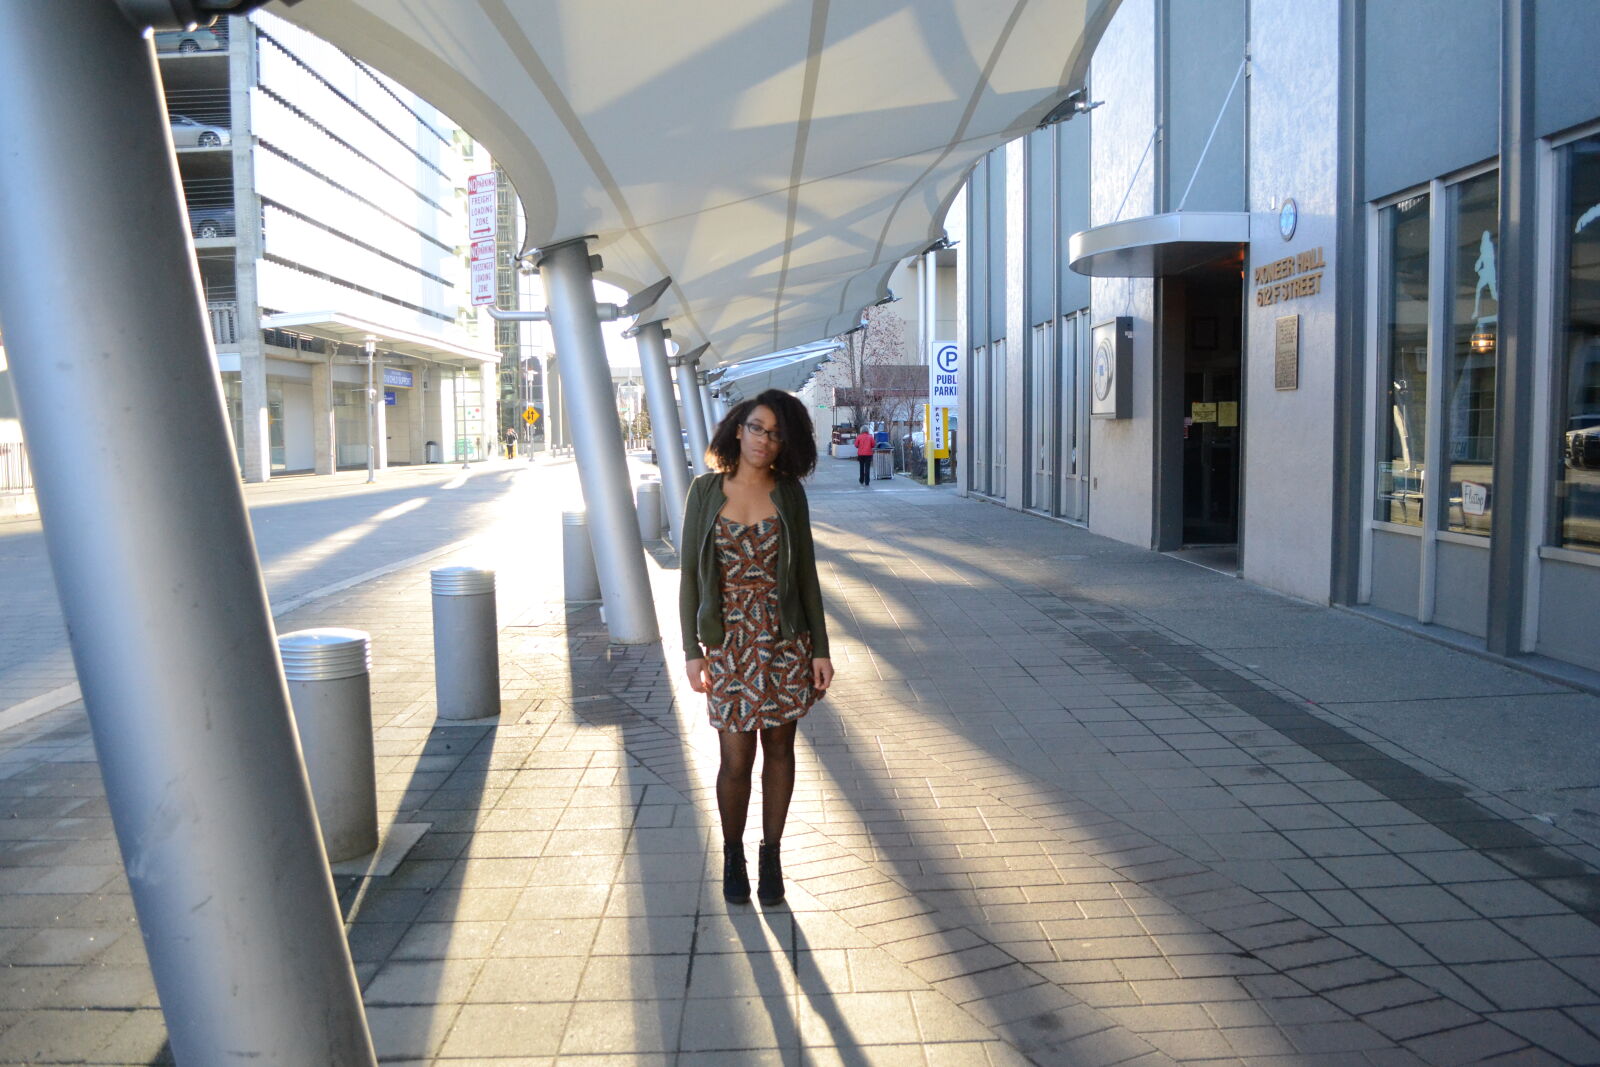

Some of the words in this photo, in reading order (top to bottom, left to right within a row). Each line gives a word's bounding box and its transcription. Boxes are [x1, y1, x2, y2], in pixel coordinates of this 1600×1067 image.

[468, 180, 477, 193] NO
[477, 178, 495, 188] PARKING
[472, 195, 492, 205] FREIGHT
[472, 205, 493, 216] LOADING
[475, 217, 489, 226] ZONE
[471, 246, 478, 258] NO
[473, 262, 493, 272] PASSENGER
[1255, 256, 1295, 285] PIONEER
[1296, 247, 1326, 273] HALL
[476, 273, 491, 283] LOADING
[478, 284, 488, 293] ZONE
[1257, 286, 1273, 307] 612
[1273, 282, 1282, 304] F
[1282, 271, 1323, 301] STREET
[936, 375, 957, 385] PUBL
[934, 386, 957, 396] PARKI
